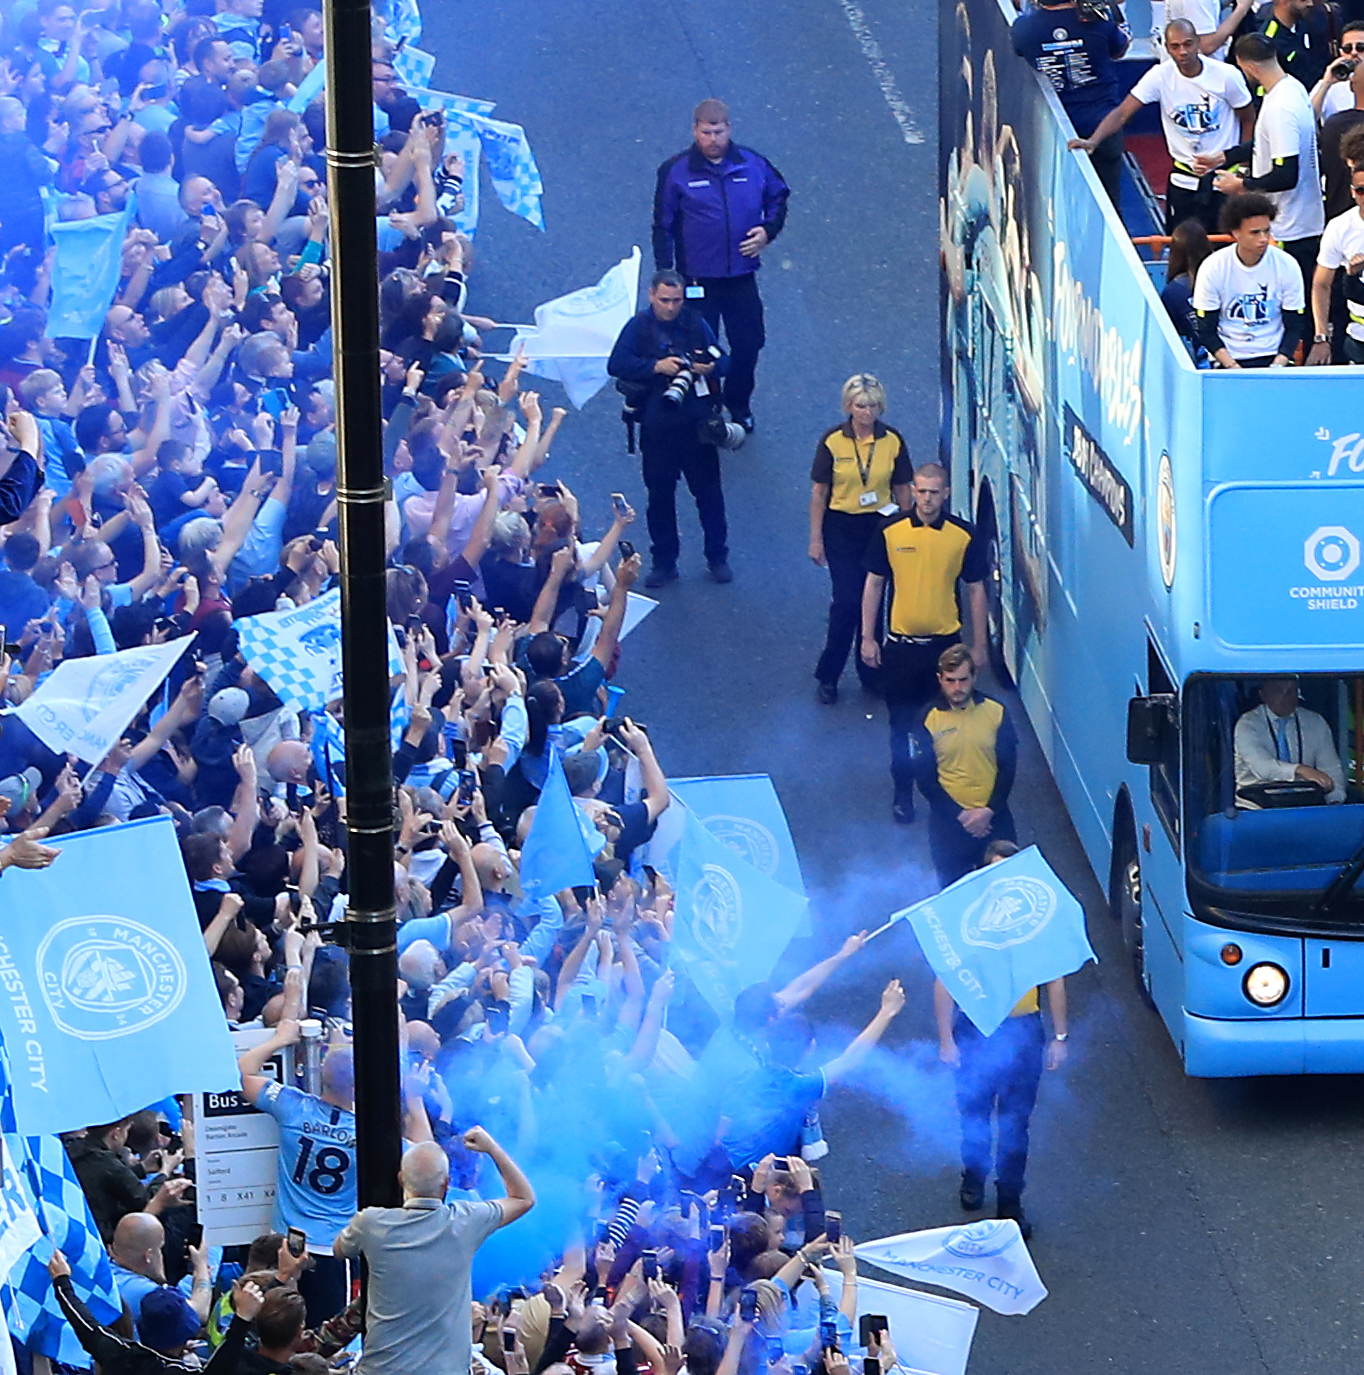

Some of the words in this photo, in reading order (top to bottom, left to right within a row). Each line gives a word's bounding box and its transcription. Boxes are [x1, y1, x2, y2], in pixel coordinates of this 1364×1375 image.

[1307, 598, 1358, 610] SHIELD
[113, 927, 175, 1016] MANCHESTER
[957, 968, 987, 1001] CITY
[43, 970, 67, 1010] CITY
[25, 1038, 49, 1094] CITY
[208, 1093, 239, 1110] Bus
[293, 1135, 350, 1195] 18
[220, 1193, 228, 1202] 8
[236, 1192, 255, 1201] X41
[957, 1240, 986, 1254] CITY
[987, 1276, 1025, 1300] CITY
